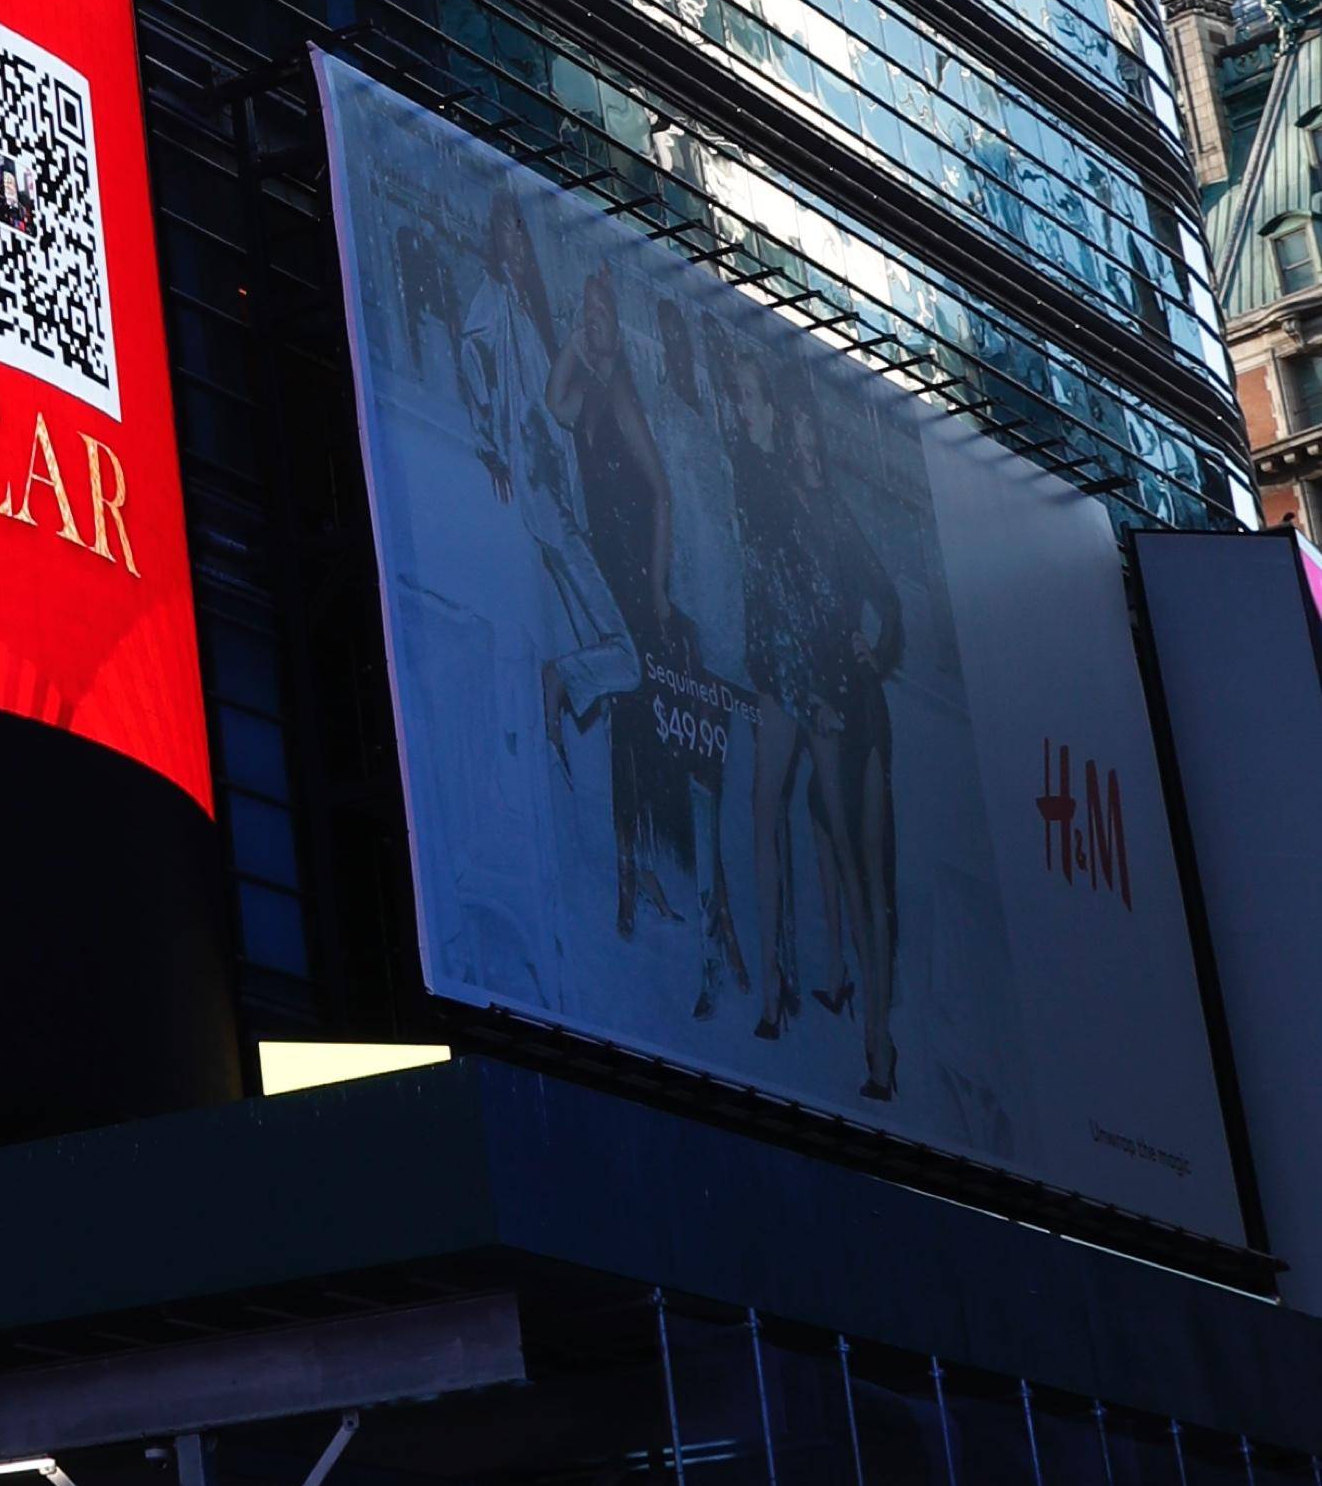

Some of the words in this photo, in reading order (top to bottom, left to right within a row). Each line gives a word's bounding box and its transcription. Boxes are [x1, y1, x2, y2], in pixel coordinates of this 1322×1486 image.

[645, 652, 718, 707] Sequined
[720, 684, 765, 727] Dress
[653, 693, 728, 764] $49.99
[1036, 737, 1132, 913] H&M
